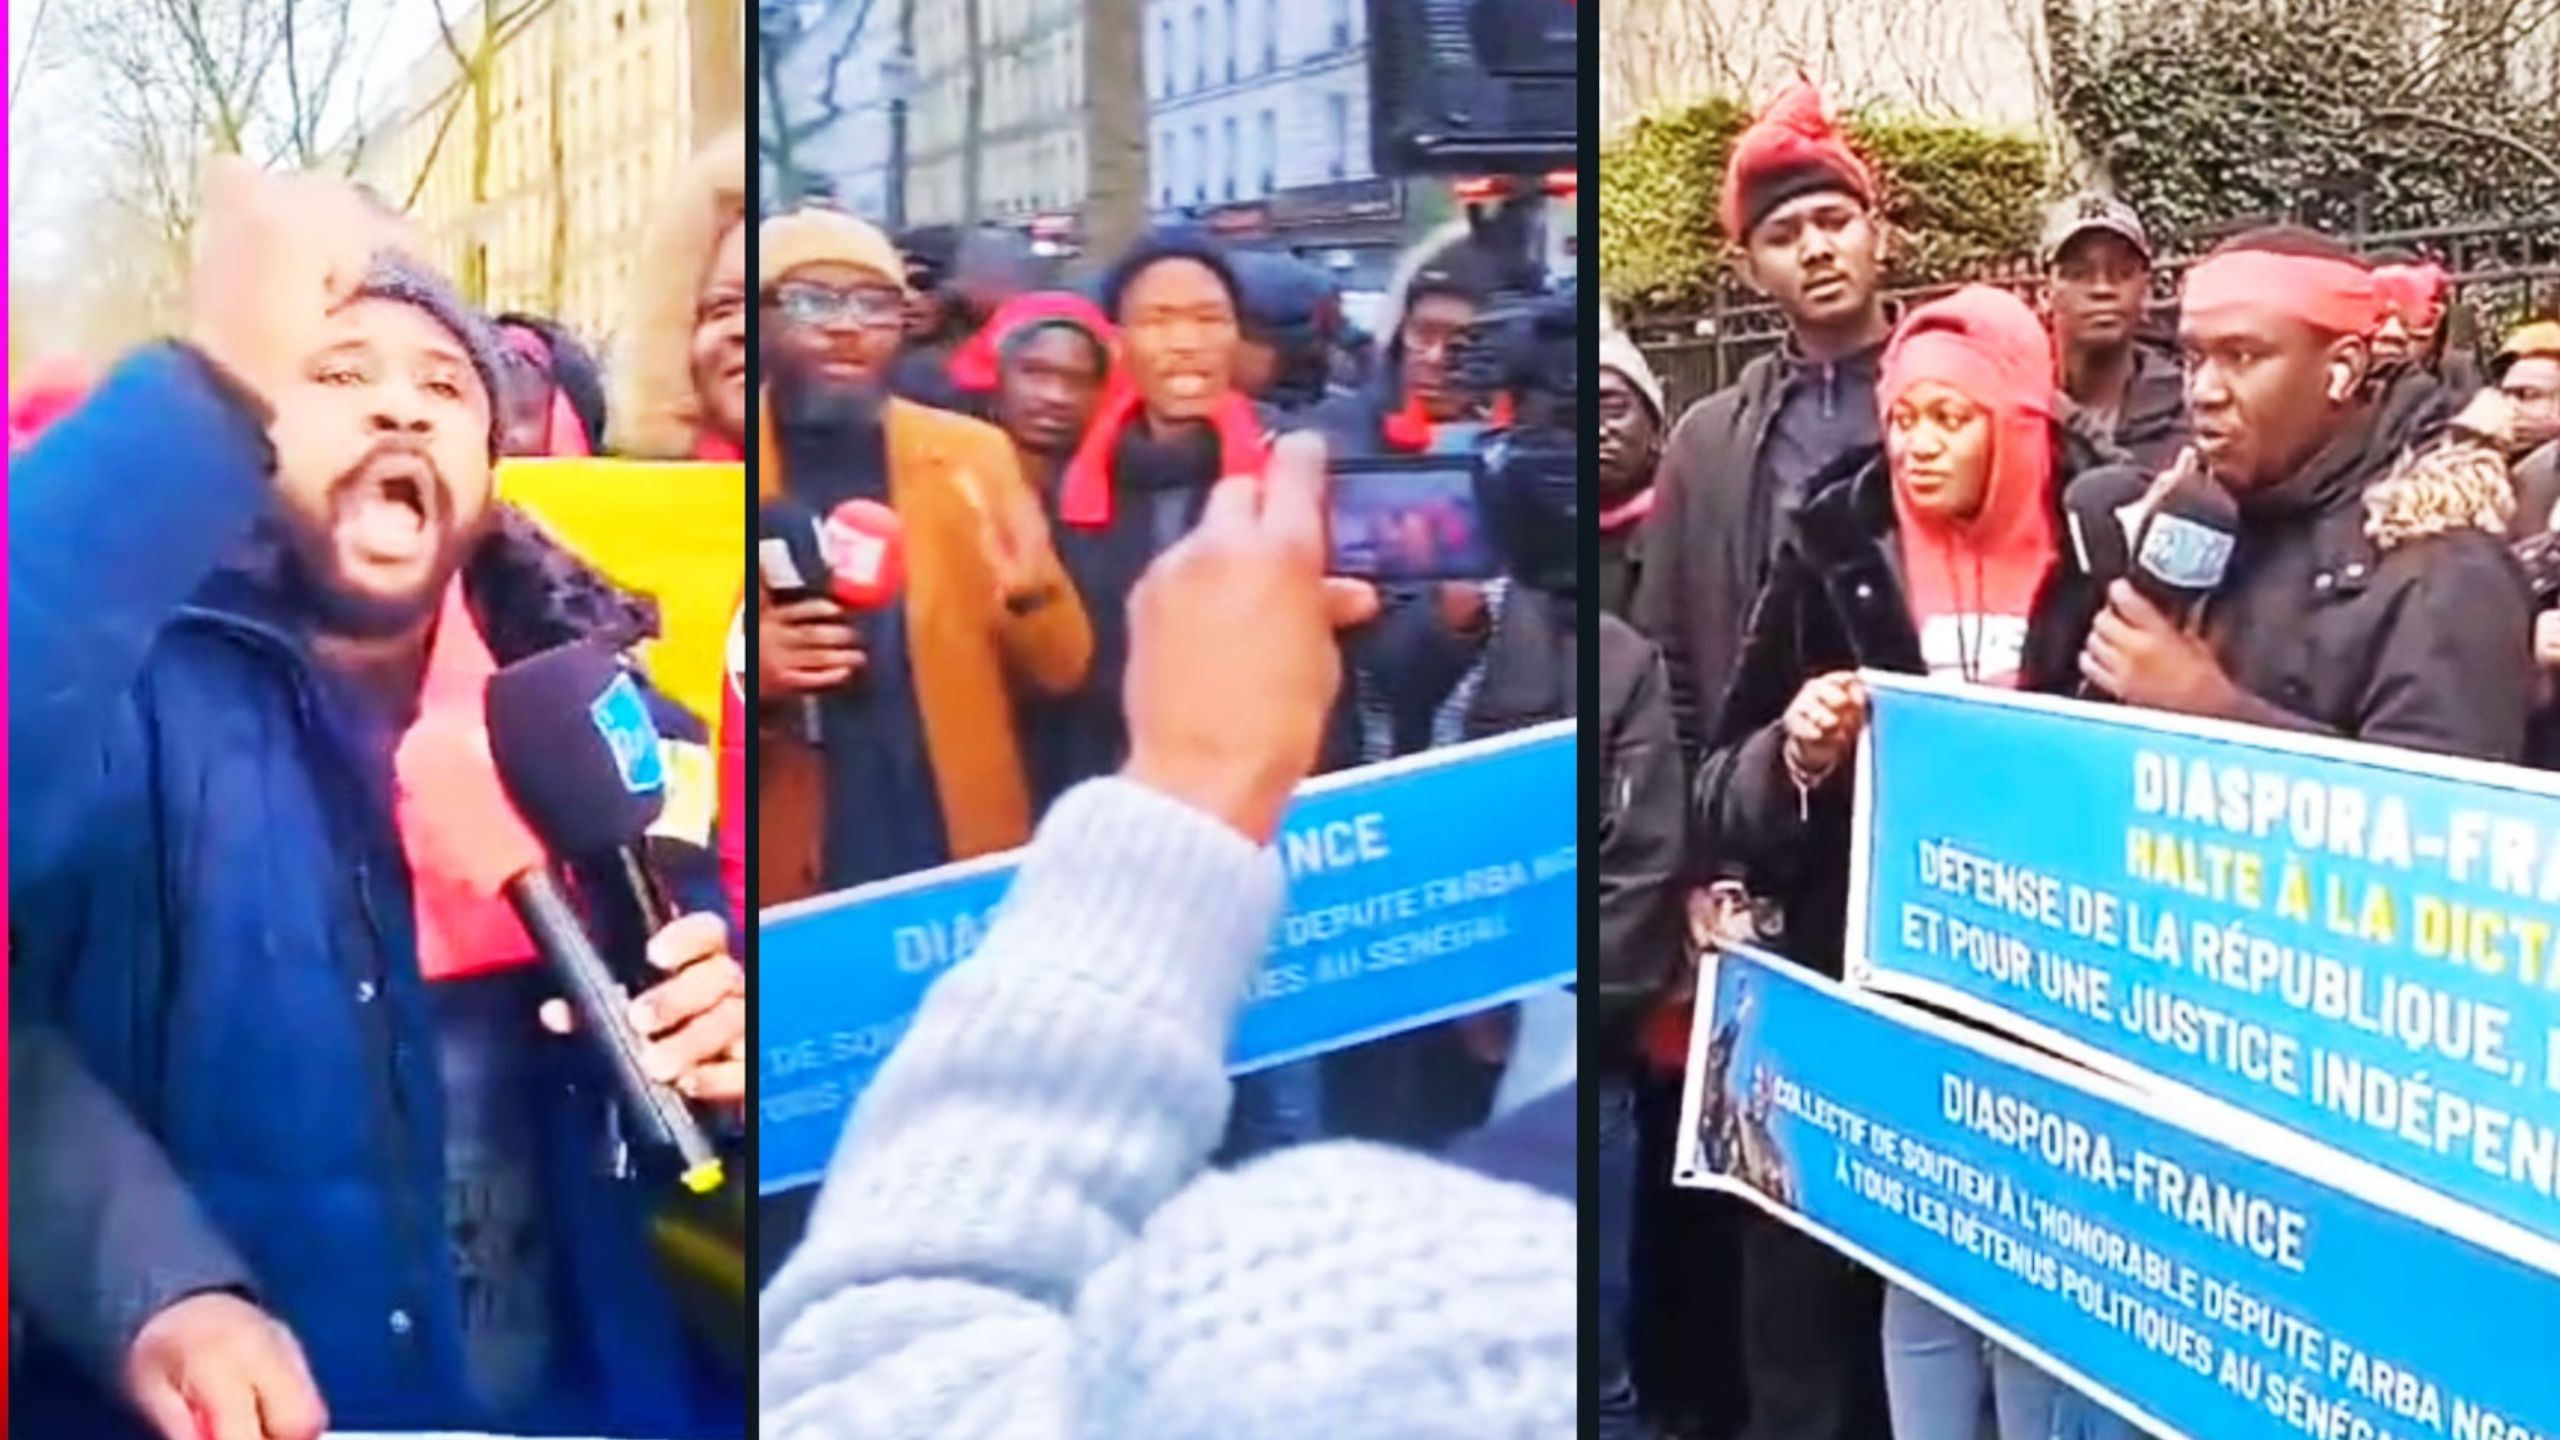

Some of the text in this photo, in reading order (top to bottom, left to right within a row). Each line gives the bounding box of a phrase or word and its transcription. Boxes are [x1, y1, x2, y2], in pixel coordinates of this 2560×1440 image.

[1918, 836, 2063, 929] DÉFENSE
[2069, 884, 2119, 947] DE
[2128, 902, 2181, 968] LA
[2193, 919, 2525, 1087] RÉPUBLIQUE,
[2126, 826, 2262, 910] HALTE
[2274, 850, 2312, 923] À
[2326, 872, 2396, 944] LA
[1903, 903, 1940, 955] ET
[1948, 918, 2031, 990] POUR
[2038, 950, 2113, 1022] UNE
[2120, 982, 2300, 1096] JUSTICE
[2311, 1047, 2560, 1201] INDÉPEN
[1943, 1072, 2306, 1272] DIASPORA-FRANCE
[1773, 1076, 1868, 1146] COLLECTIF
[1871, 1122, 1898, 1161] DE
[1901, 1137, 1994, 1210] SOUTIEN
[2000, 1176, 2015, 1221] À
[2020, 1190, 2198, 1310] L'HONORABLE
[2328, 1339, 2443, 1433] FARBA
[1836, 1146, 1849, 1187] À
[1851, 1160, 1903, 1214] TOUS
[1907, 1188, 1949, 1237] LES
[1952, 1210, 2057, 1291] DÉTENUS
[2061, 1264, 2213, 1376] POLITIQUES
[2219, 1348, 2261, 1401] AU
